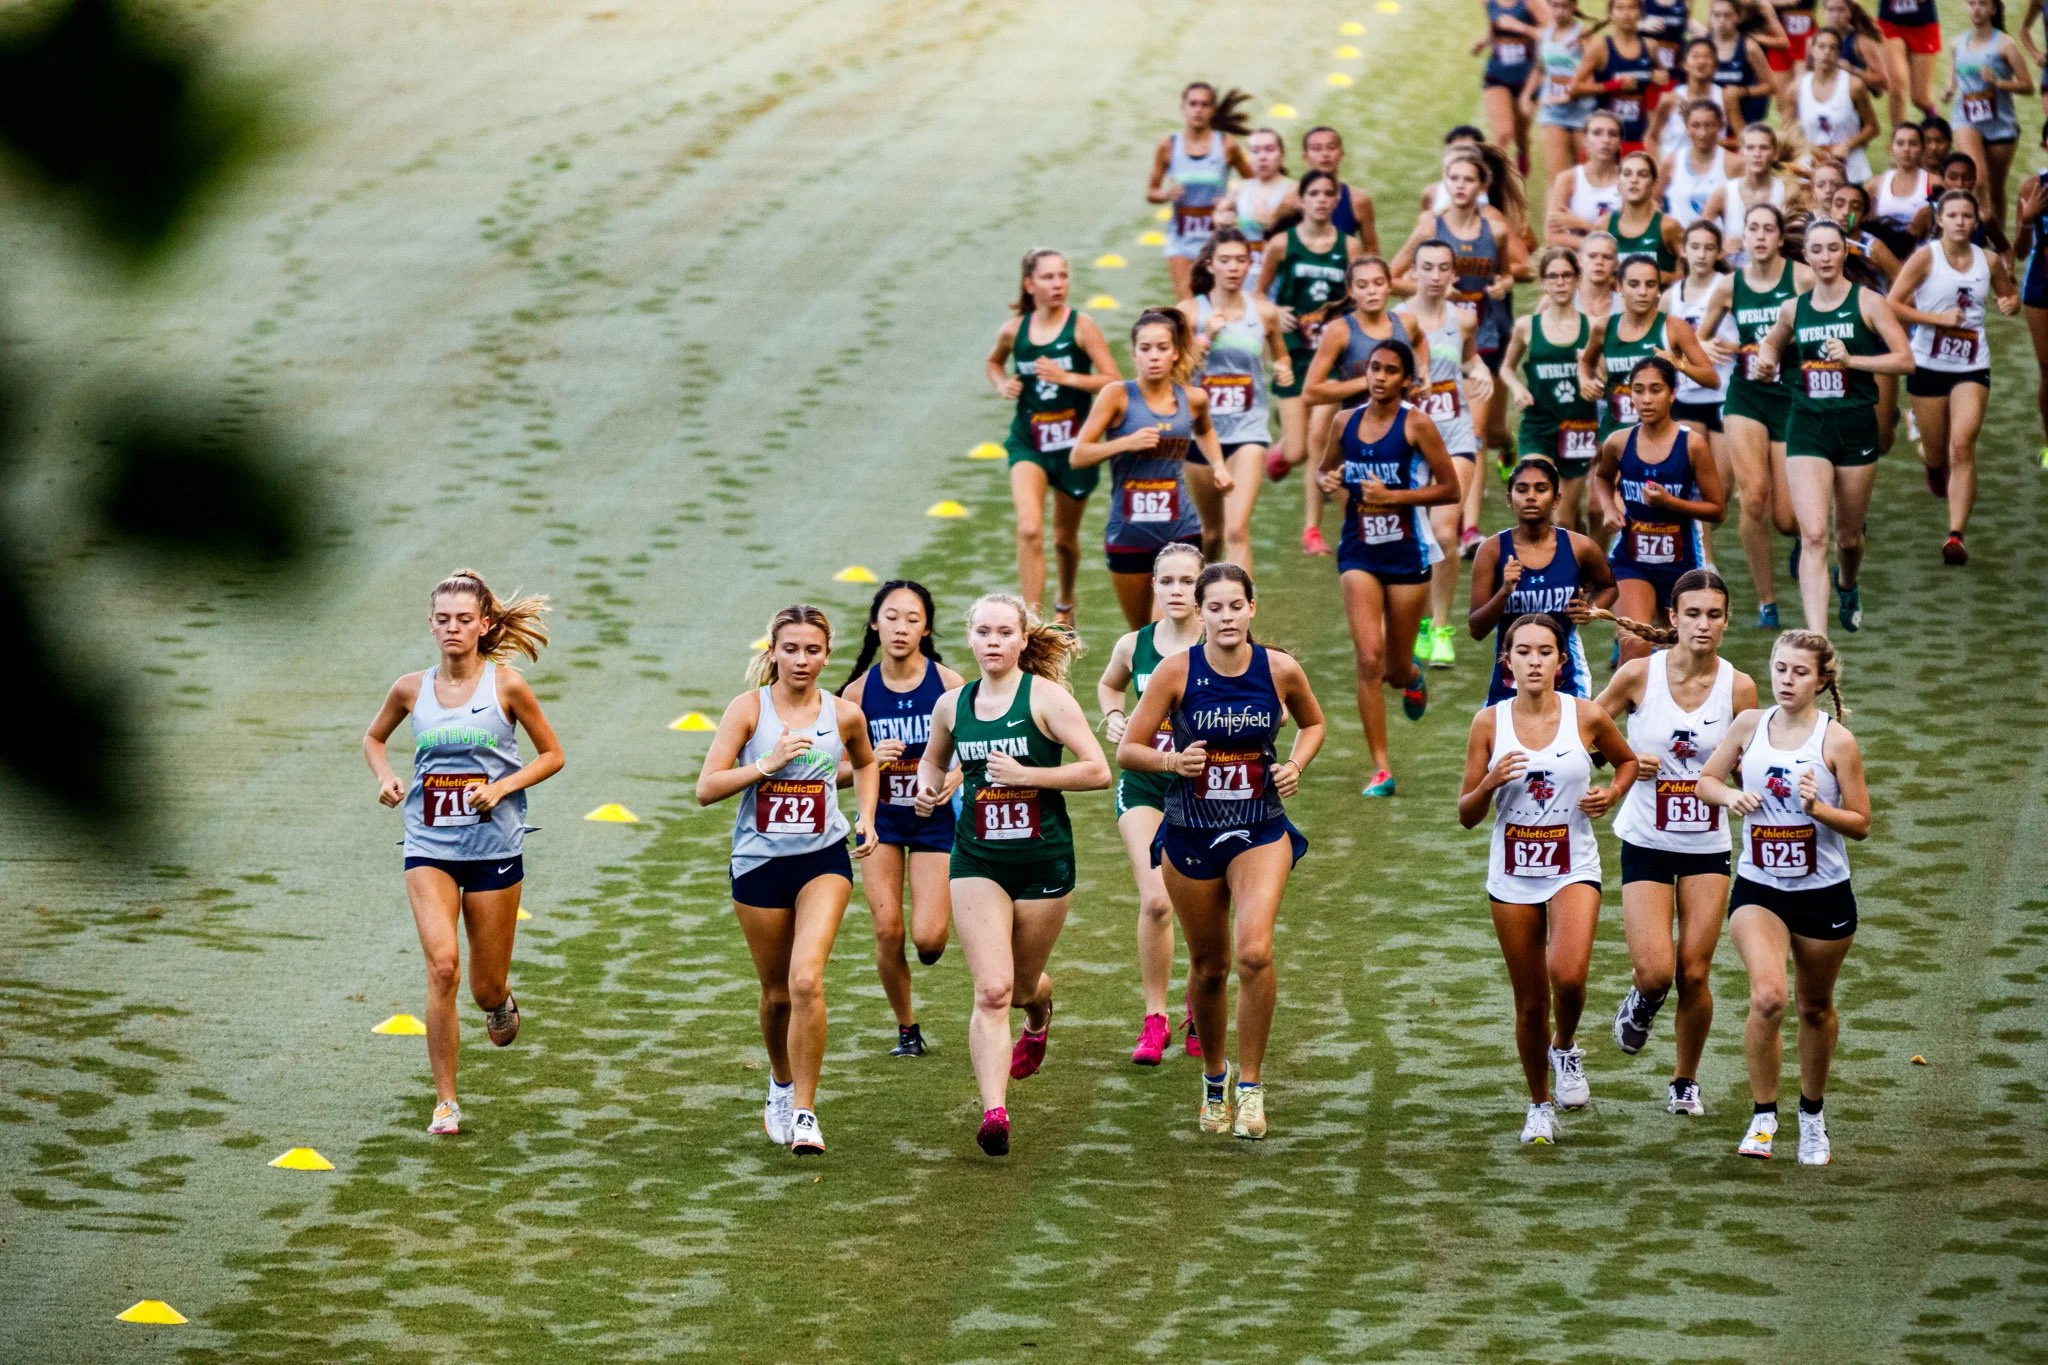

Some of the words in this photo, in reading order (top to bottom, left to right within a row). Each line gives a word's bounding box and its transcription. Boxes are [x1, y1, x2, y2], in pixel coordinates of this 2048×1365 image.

[1738, 306, 1781, 325] WESLEY
[1799, 322, 1855, 344] WESLEYAN
[1941, 337, 1972, 357] 628
[1537, 363, 1578, 379] WESLEY
[1809, 371, 1843, 390] 808
[1038, 420, 1073, 443] 797
[1566, 431, 1597, 450] 812
[1132, 491, 1172, 513] 662
[1363, 514, 1403, 537] 582
[1637, 534, 1675, 555] 576
[1193, 705, 1271, 736] Whitefield
[957, 736, 1030, 761] WESLEYAN
[1205, 752, 1242, 763] thletic
[889, 775, 918, 797] 57
[1208, 764, 1251, 789] 871
[1657, 781, 1696, 793] Athlet
[769, 797, 815, 823] 732
[985, 803, 1030, 829] 813
[1667, 796, 1710, 822] 636
[1514, 842, 1558, 867] 627
[1761, 842, 1806, 867] 625
